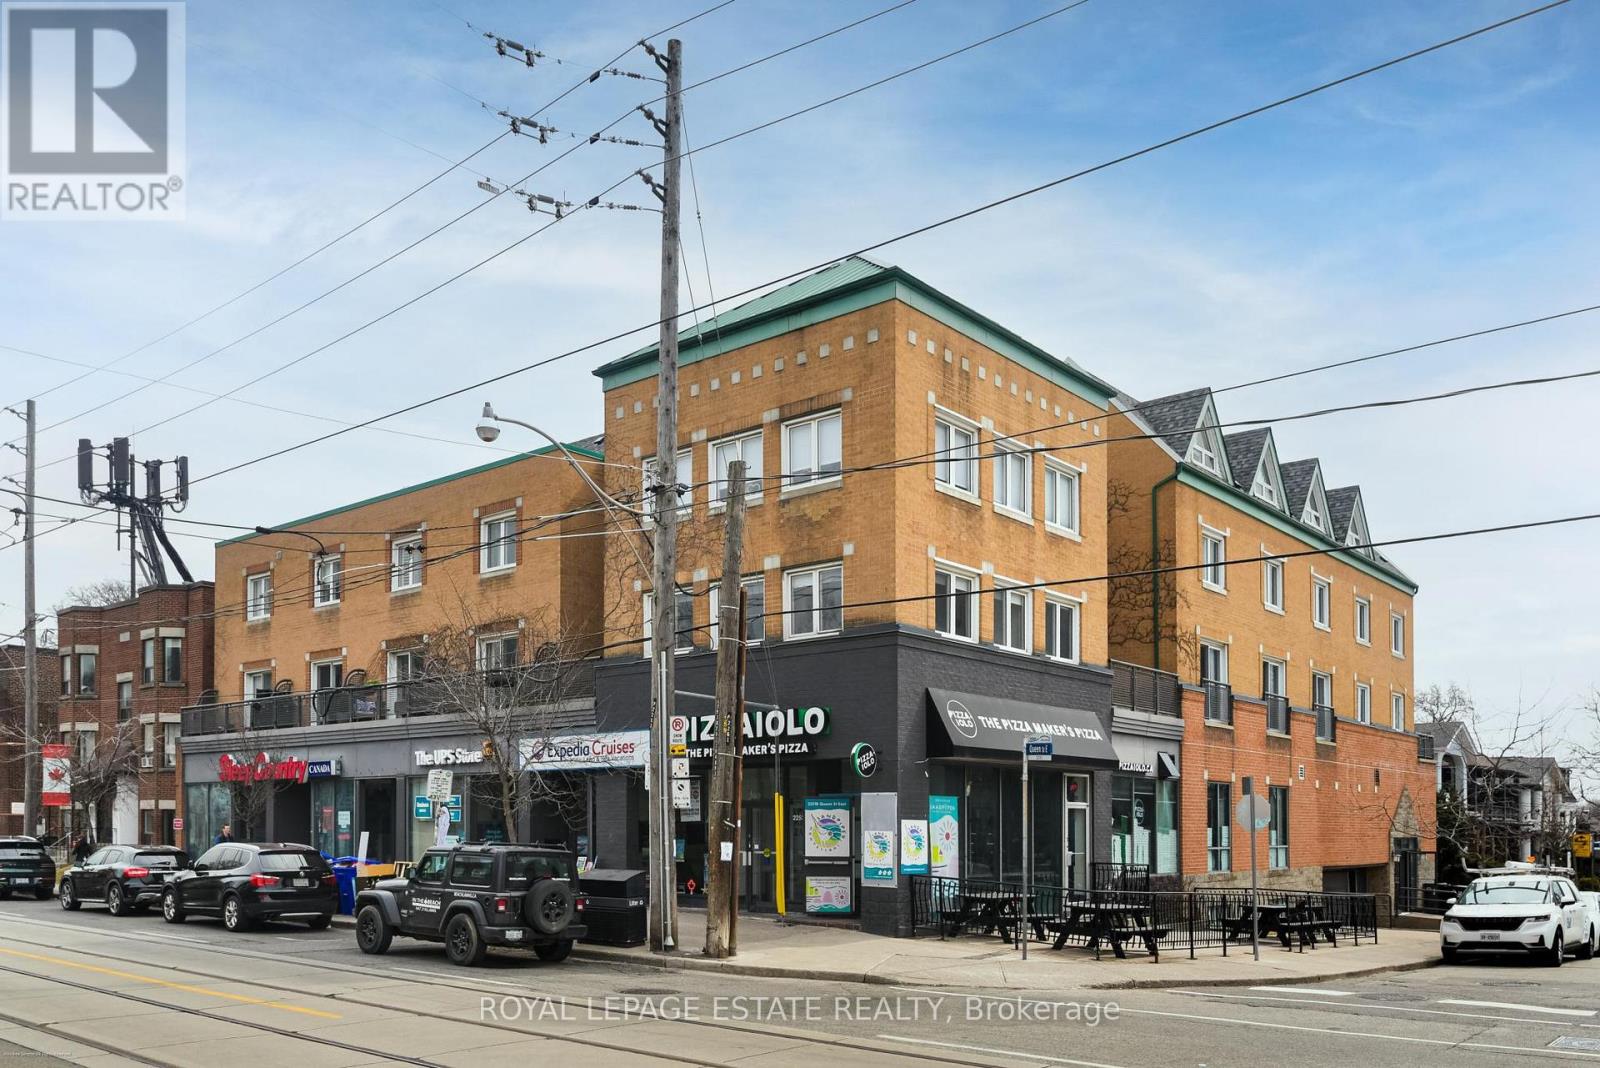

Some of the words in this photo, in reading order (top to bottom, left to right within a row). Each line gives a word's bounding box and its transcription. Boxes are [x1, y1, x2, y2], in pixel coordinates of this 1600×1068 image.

[978, 716, 1002, 729] THE
[1001, 718, 1033, 733] PIZZA
[1032, 723, 1075, 737] MAKER'S
[1074, 727, 1103, 741] PIZZA
[415, 750, 434, 766] The
[434, 749, 455, 765] UPS
[455, 748, 483, 764] Store
[547, 741, 590, 761] Expedia
[592, 740, 635, 755] Cruises
[685, 747, 702, 758] THE
[779, 743, 808, 754] PIZZA
[857, 750, 874, 766] PIZZA
[309, 764, 331, 774] CANADA
[861, 757, 875, 770] IOLO
